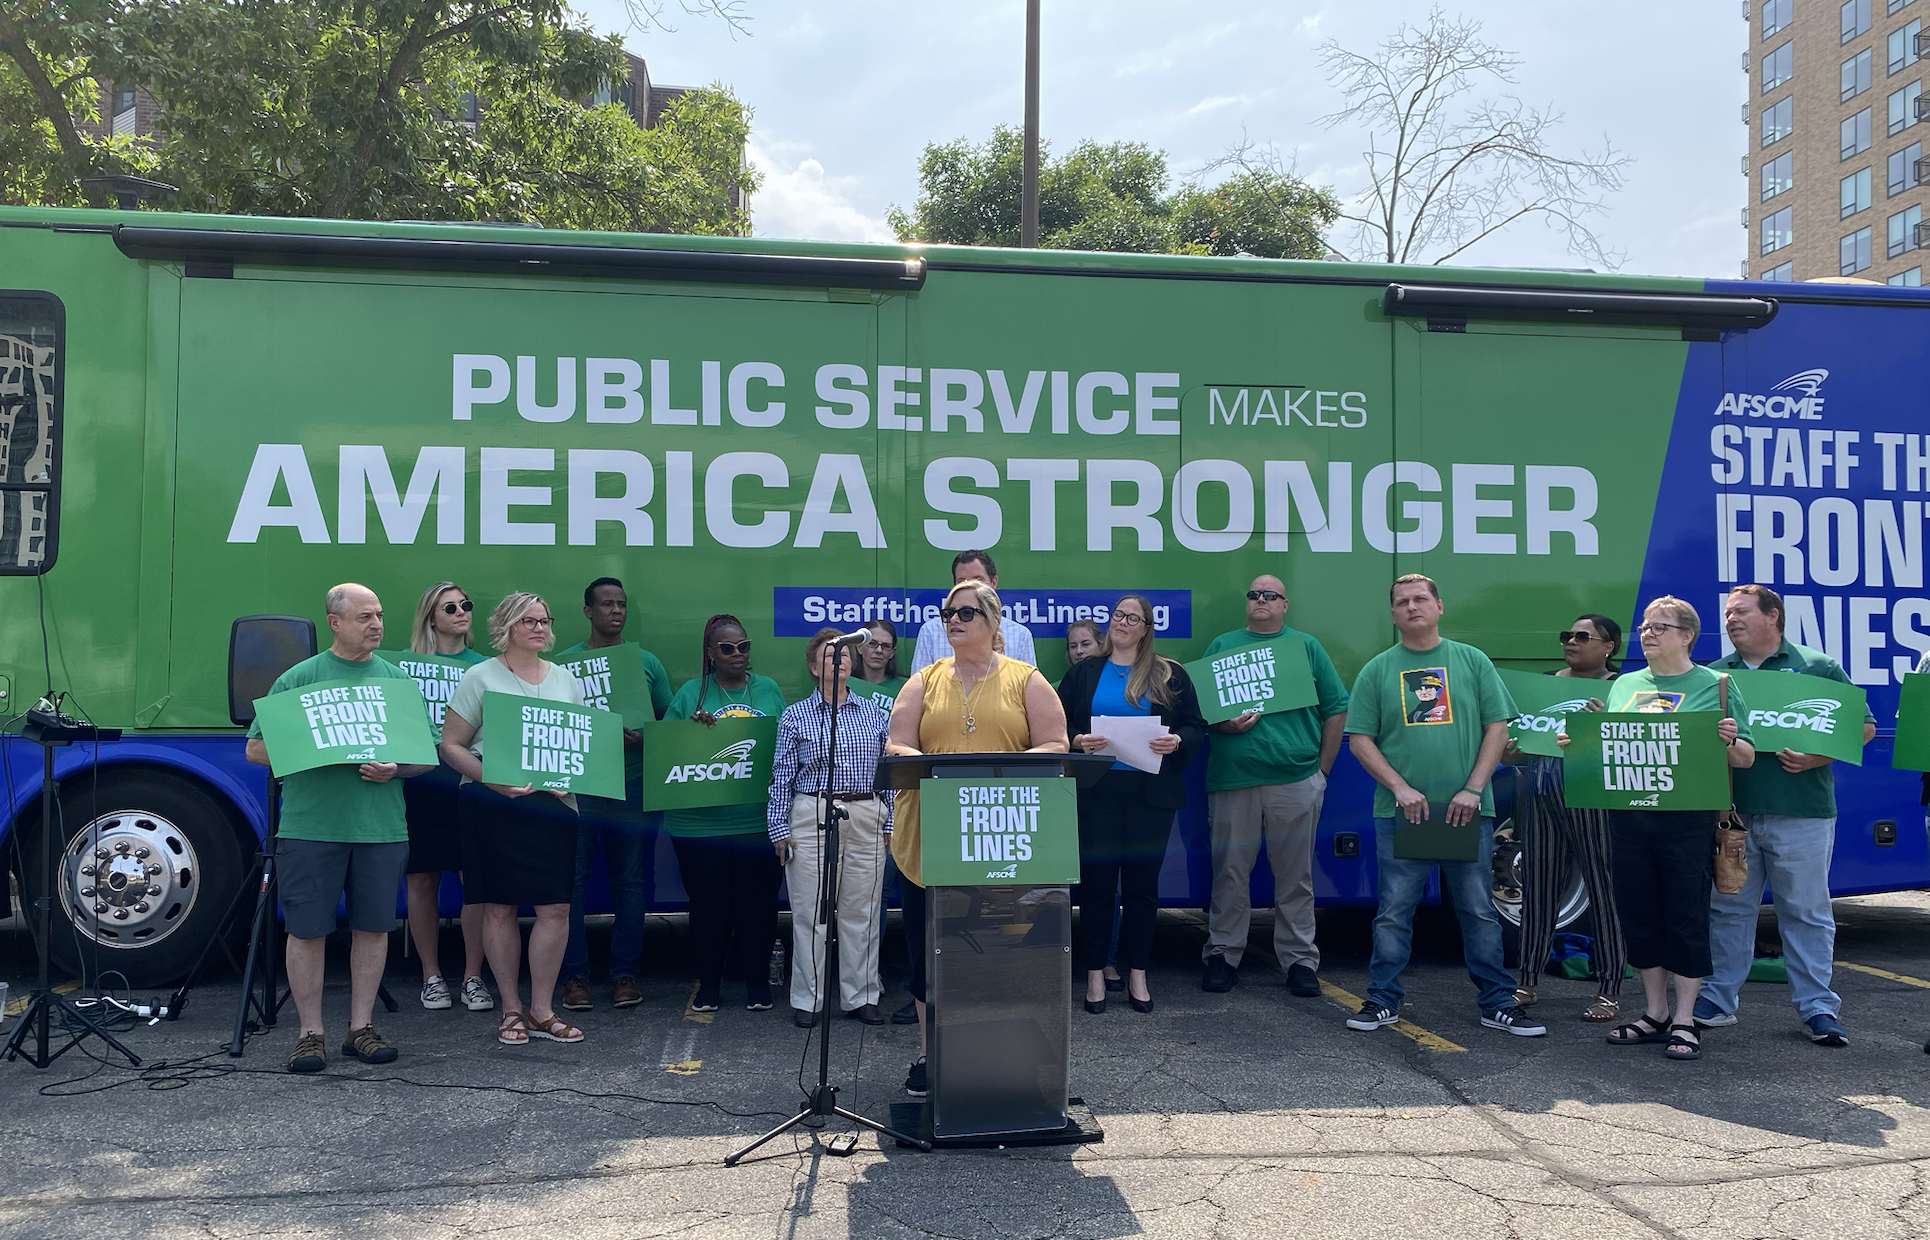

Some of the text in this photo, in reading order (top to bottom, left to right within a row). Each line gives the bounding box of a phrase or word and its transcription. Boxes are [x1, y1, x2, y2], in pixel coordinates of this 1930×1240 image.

[452, 353, 1368, 436] PUBLIC SERVICE MAKES
[1714, 393, 1825, 420] AFSCME
[1710, 424, 1860, 489] STAFF
[226, 443, 1599, 556] AMERICA STRONGER
[1716, 493, 1930, 589] FRON
[1719, 593, 1930, 685] NES
[399, 660, 439, 678] STAFF
[583, 656, 610, 674] THE
[1211, 647, 1274, 673] STAFF THE
[576, 672, 612, 698] ONT
[1214, 660, 1276, 690] FRONT
[300, 685, 385, 708] STAFF THE
[871, 691, 894, 711] STA
[1218, 680, 1275, 708] LINES
[305, 700, 388, 729] FRONT
[521, 705, 593, 731] STAFF THE
[1748, 709, 1837, 735] FSCME
[312, 723, 388, 750] LINES
[522, 722, 593, 754] FRONT
[1600, 722, 1680, 739] STAFF THE
[346, 752, 377, 760] AFSCME
[521, 746, 585, 776] LINES
[1602, 740, 1681, 766] FRONT
[542, 780, 571, 789] AFSCME
[664, 761, 754, 784] AFSCME
[1603, 766, 1674, 791] LINES
[958, 786, 1040, 805] STAFF THE
[1628, 799, 1659, 807] AFSCME
[960, 805, 1041, 833] FRONT
[961, 833, 1033, 862] LINES
[986, 871, 1017, 879] AFSCME
